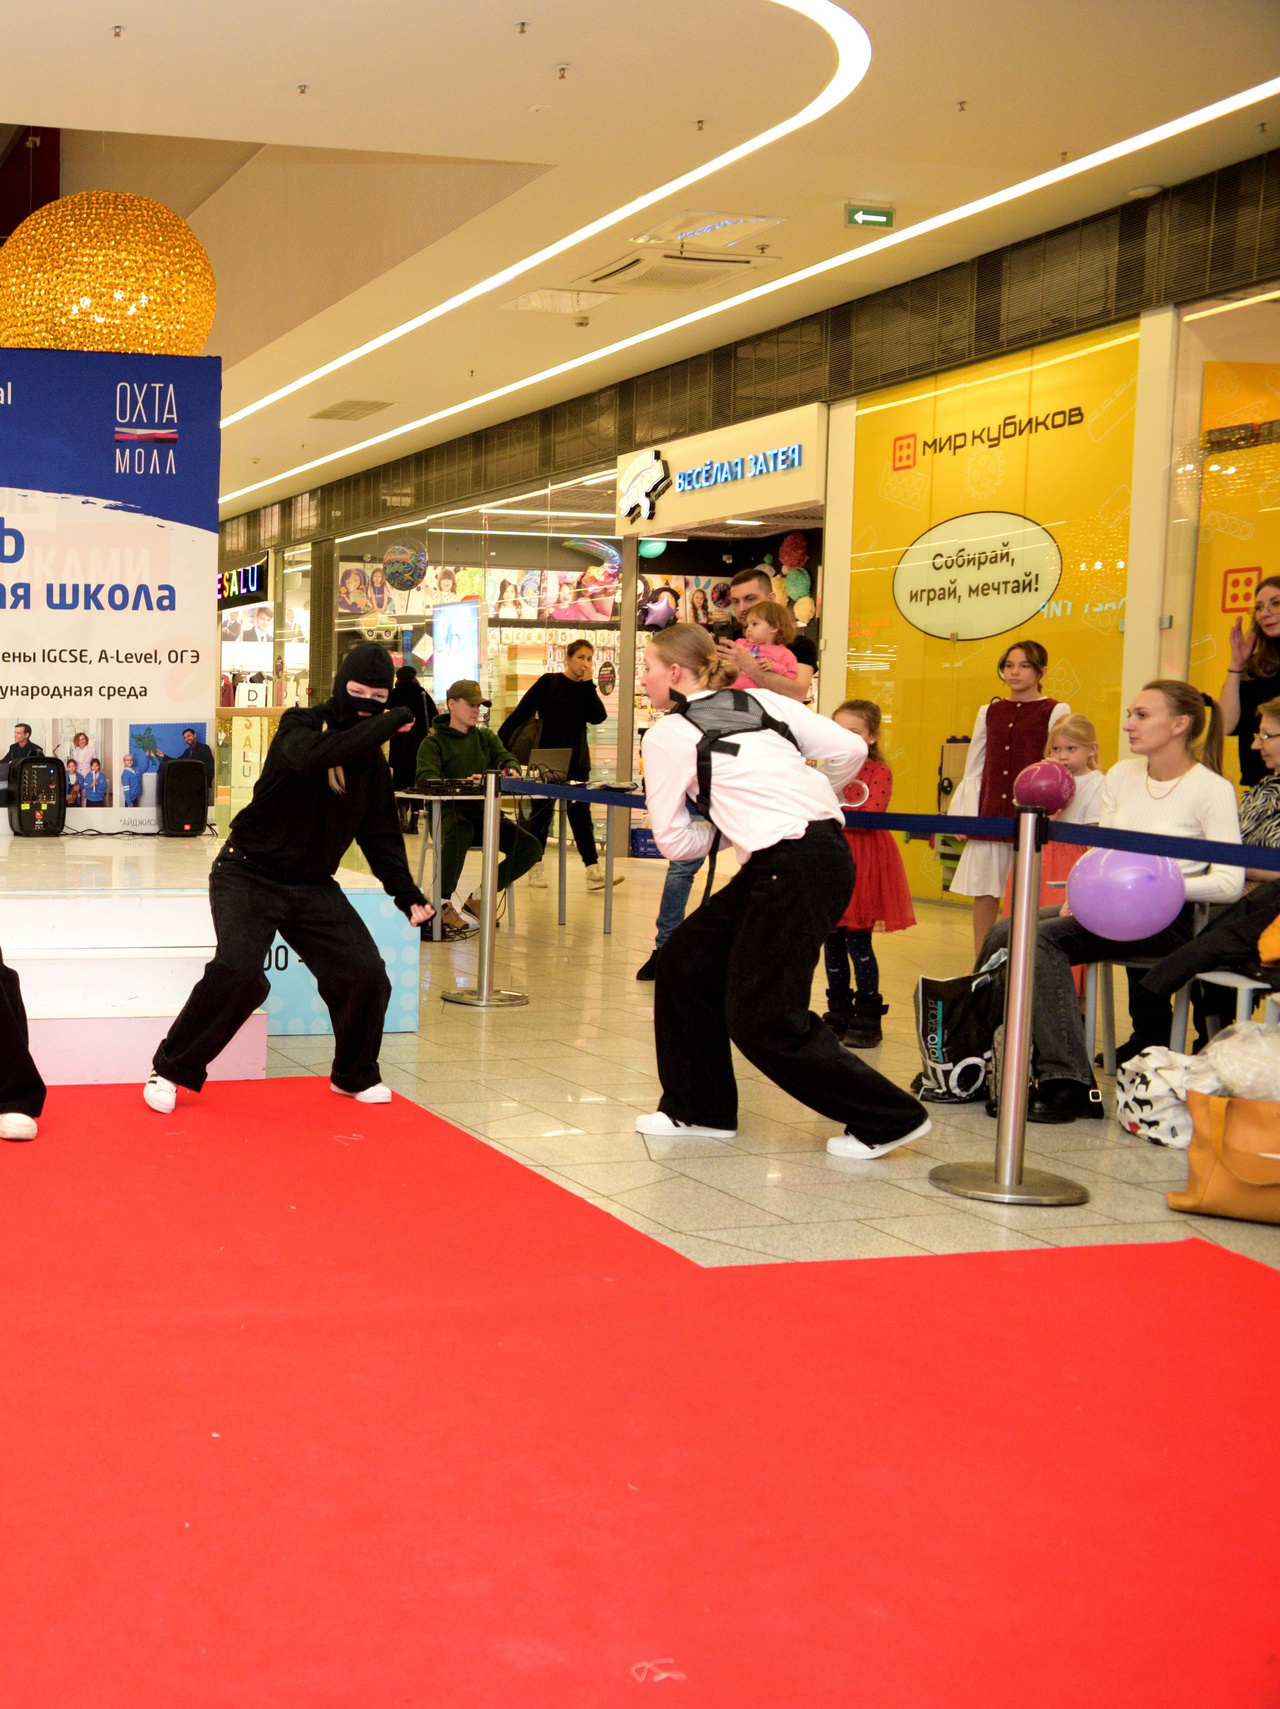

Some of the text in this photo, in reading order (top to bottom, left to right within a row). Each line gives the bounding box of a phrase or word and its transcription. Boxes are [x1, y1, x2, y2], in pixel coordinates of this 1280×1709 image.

[116, 382, 178, 424] ОХТА
[115, 448, 176, 475] МОЛЛ
[675, 456, 745, 493] ВЕСЁЛАЯ
[746, 443, 803, 478] ЗАТЕЯ
[932, 542, 1015, 572] Собирай,
[45, 582, 177, 612] школа
[909, 572, 1040, 606] играй, мечтай!
[41, 649, 92, 665] IGCSE,
[98, 649, 162, 665] A-Level,
[167, 650, 200, 664] ОГЭ
[98, 685, 148, 700] среда
